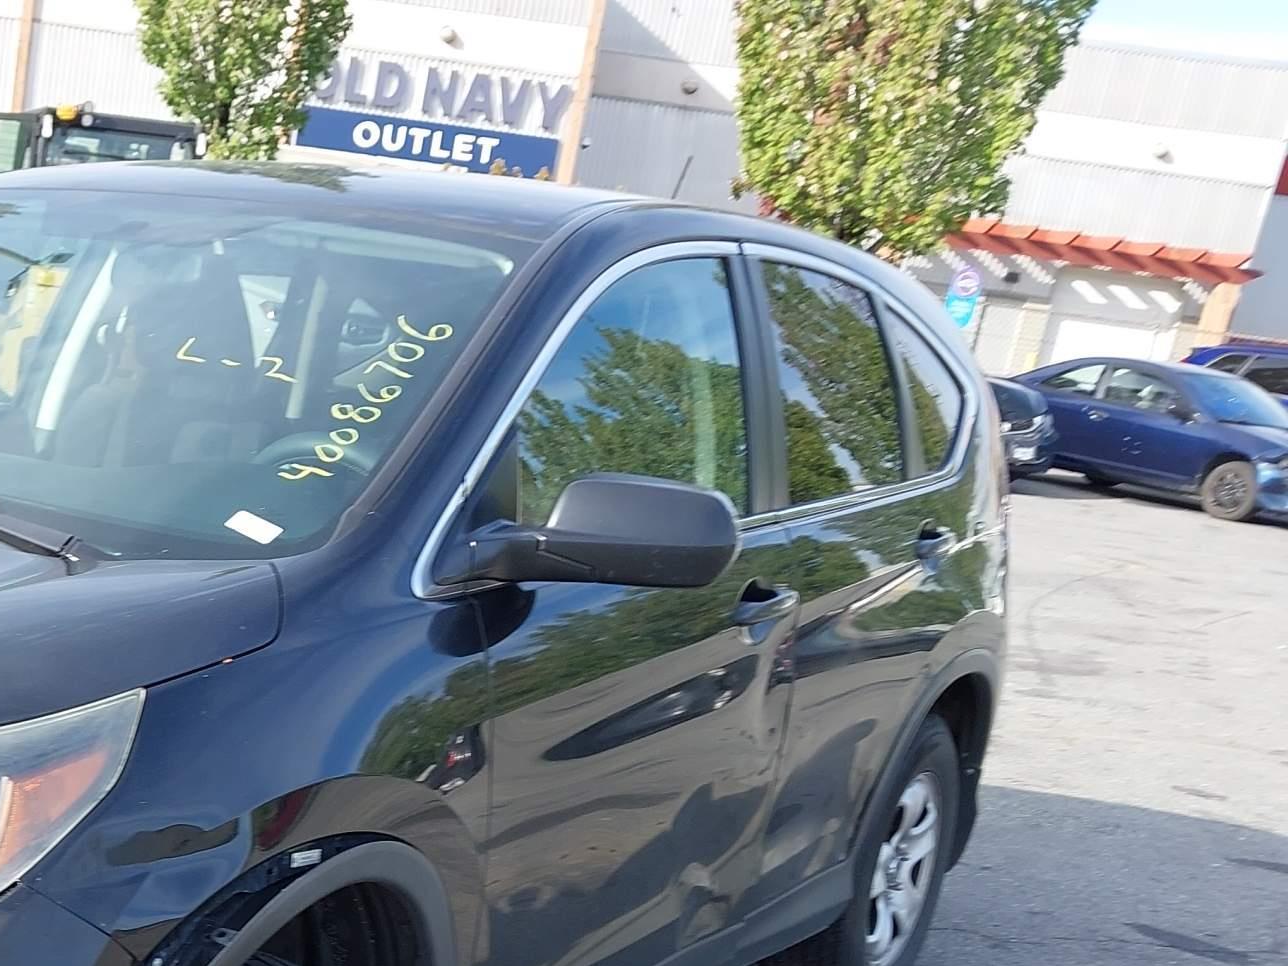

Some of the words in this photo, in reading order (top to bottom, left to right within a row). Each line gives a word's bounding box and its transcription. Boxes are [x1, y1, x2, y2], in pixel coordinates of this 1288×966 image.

[422, 66, 574, 130] NAVY
[352, 120, 500, 164] OUTLET
[277, 314, 454, 480] 40086706
